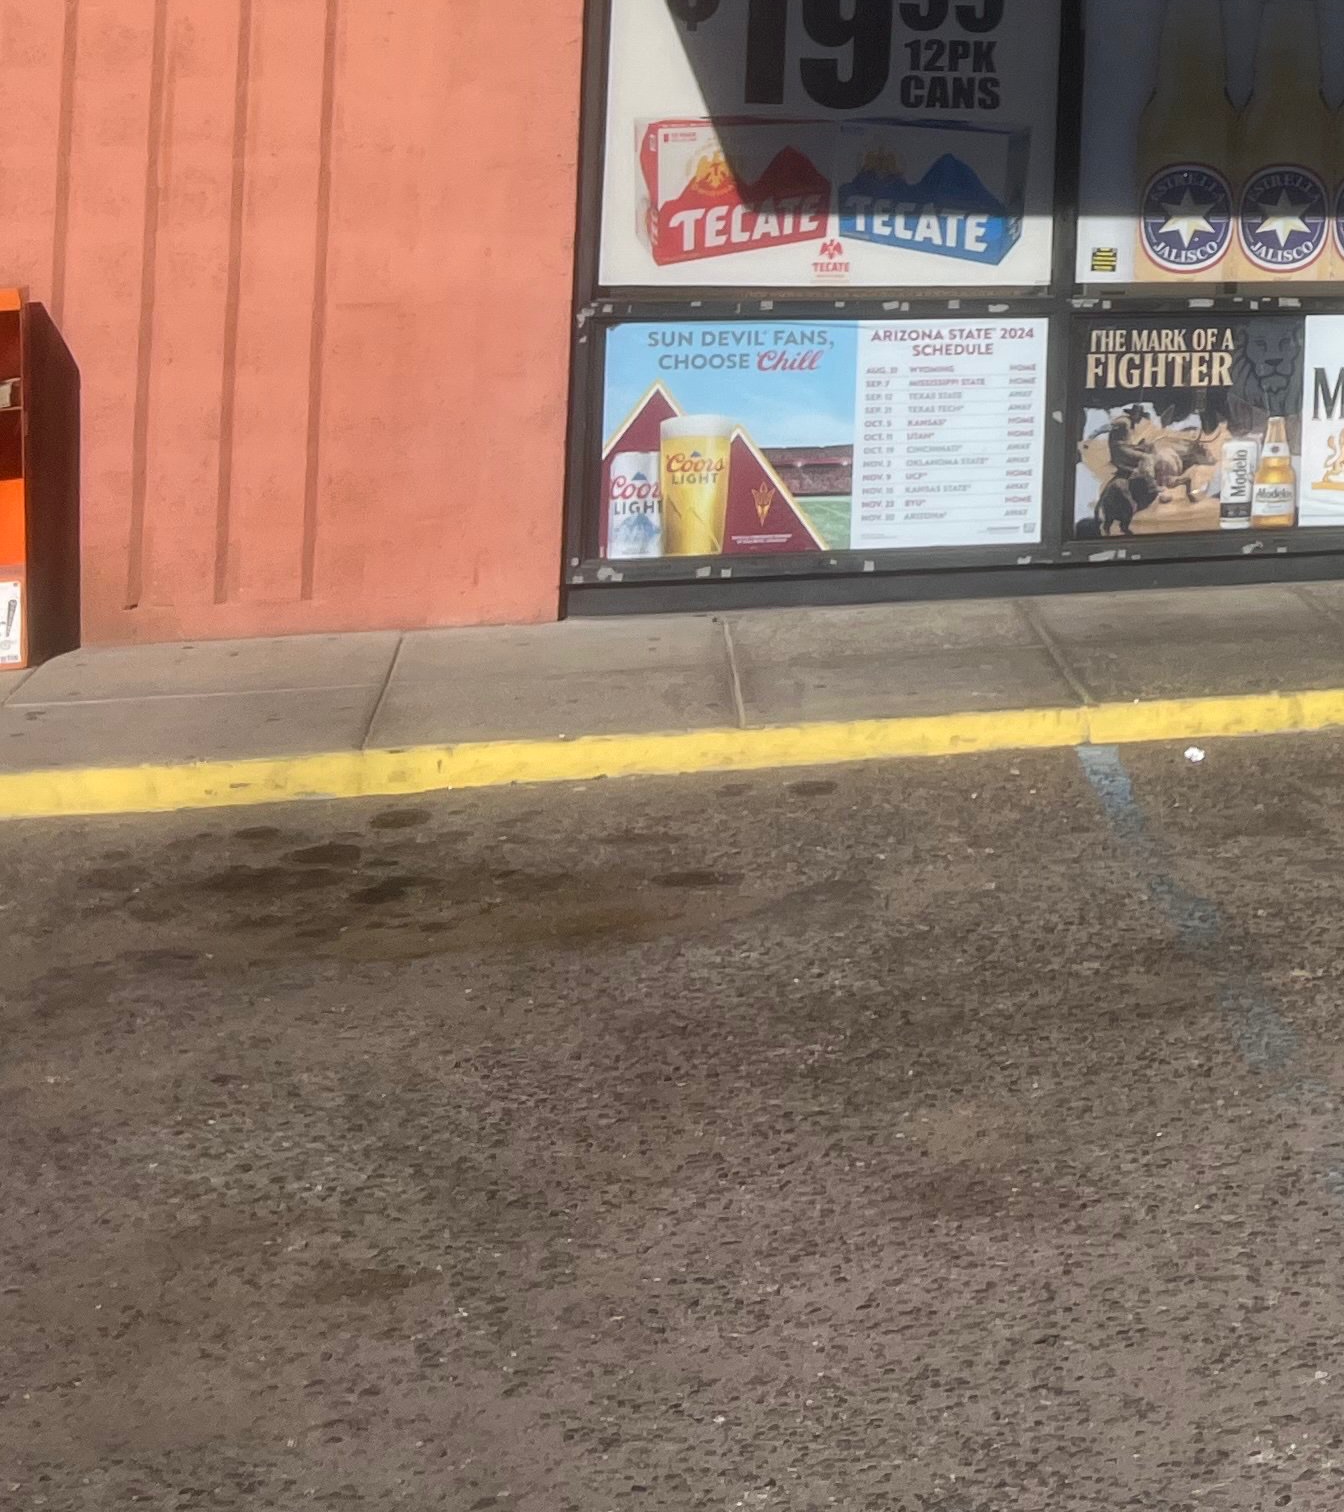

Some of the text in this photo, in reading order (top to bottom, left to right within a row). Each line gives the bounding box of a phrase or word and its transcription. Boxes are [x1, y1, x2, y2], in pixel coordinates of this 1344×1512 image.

[905, 40, 997, 73] 12PK
[901, 74, 1001, 110] CANS
[669, 194, 823, 251] TECATE
[843, 194, 990, 252] TECATE
[1153, 241, 1219, 262] JALISCO
[1251, 240, 1314, 262] JALISCO
[811, 262, 850, 273] TECATE
[648, 330, 834, 349] SUN DEVIL FANS,
[871, 327, 1034, 342] ARIZONA STATE 2024
[1091, 327, 1235, 353] THE MARK OF A
[658, 349, 824, 371] CHOOSE Chill
[912, 343, 994, 356] SCHEDULE
[1086, 350, 1235, 389] FIGHTER
[666, 453, 724, 472] Coors
[1230, 449, 1248, 497] Modelo
[671, 473, 718, 484] LIGHT
